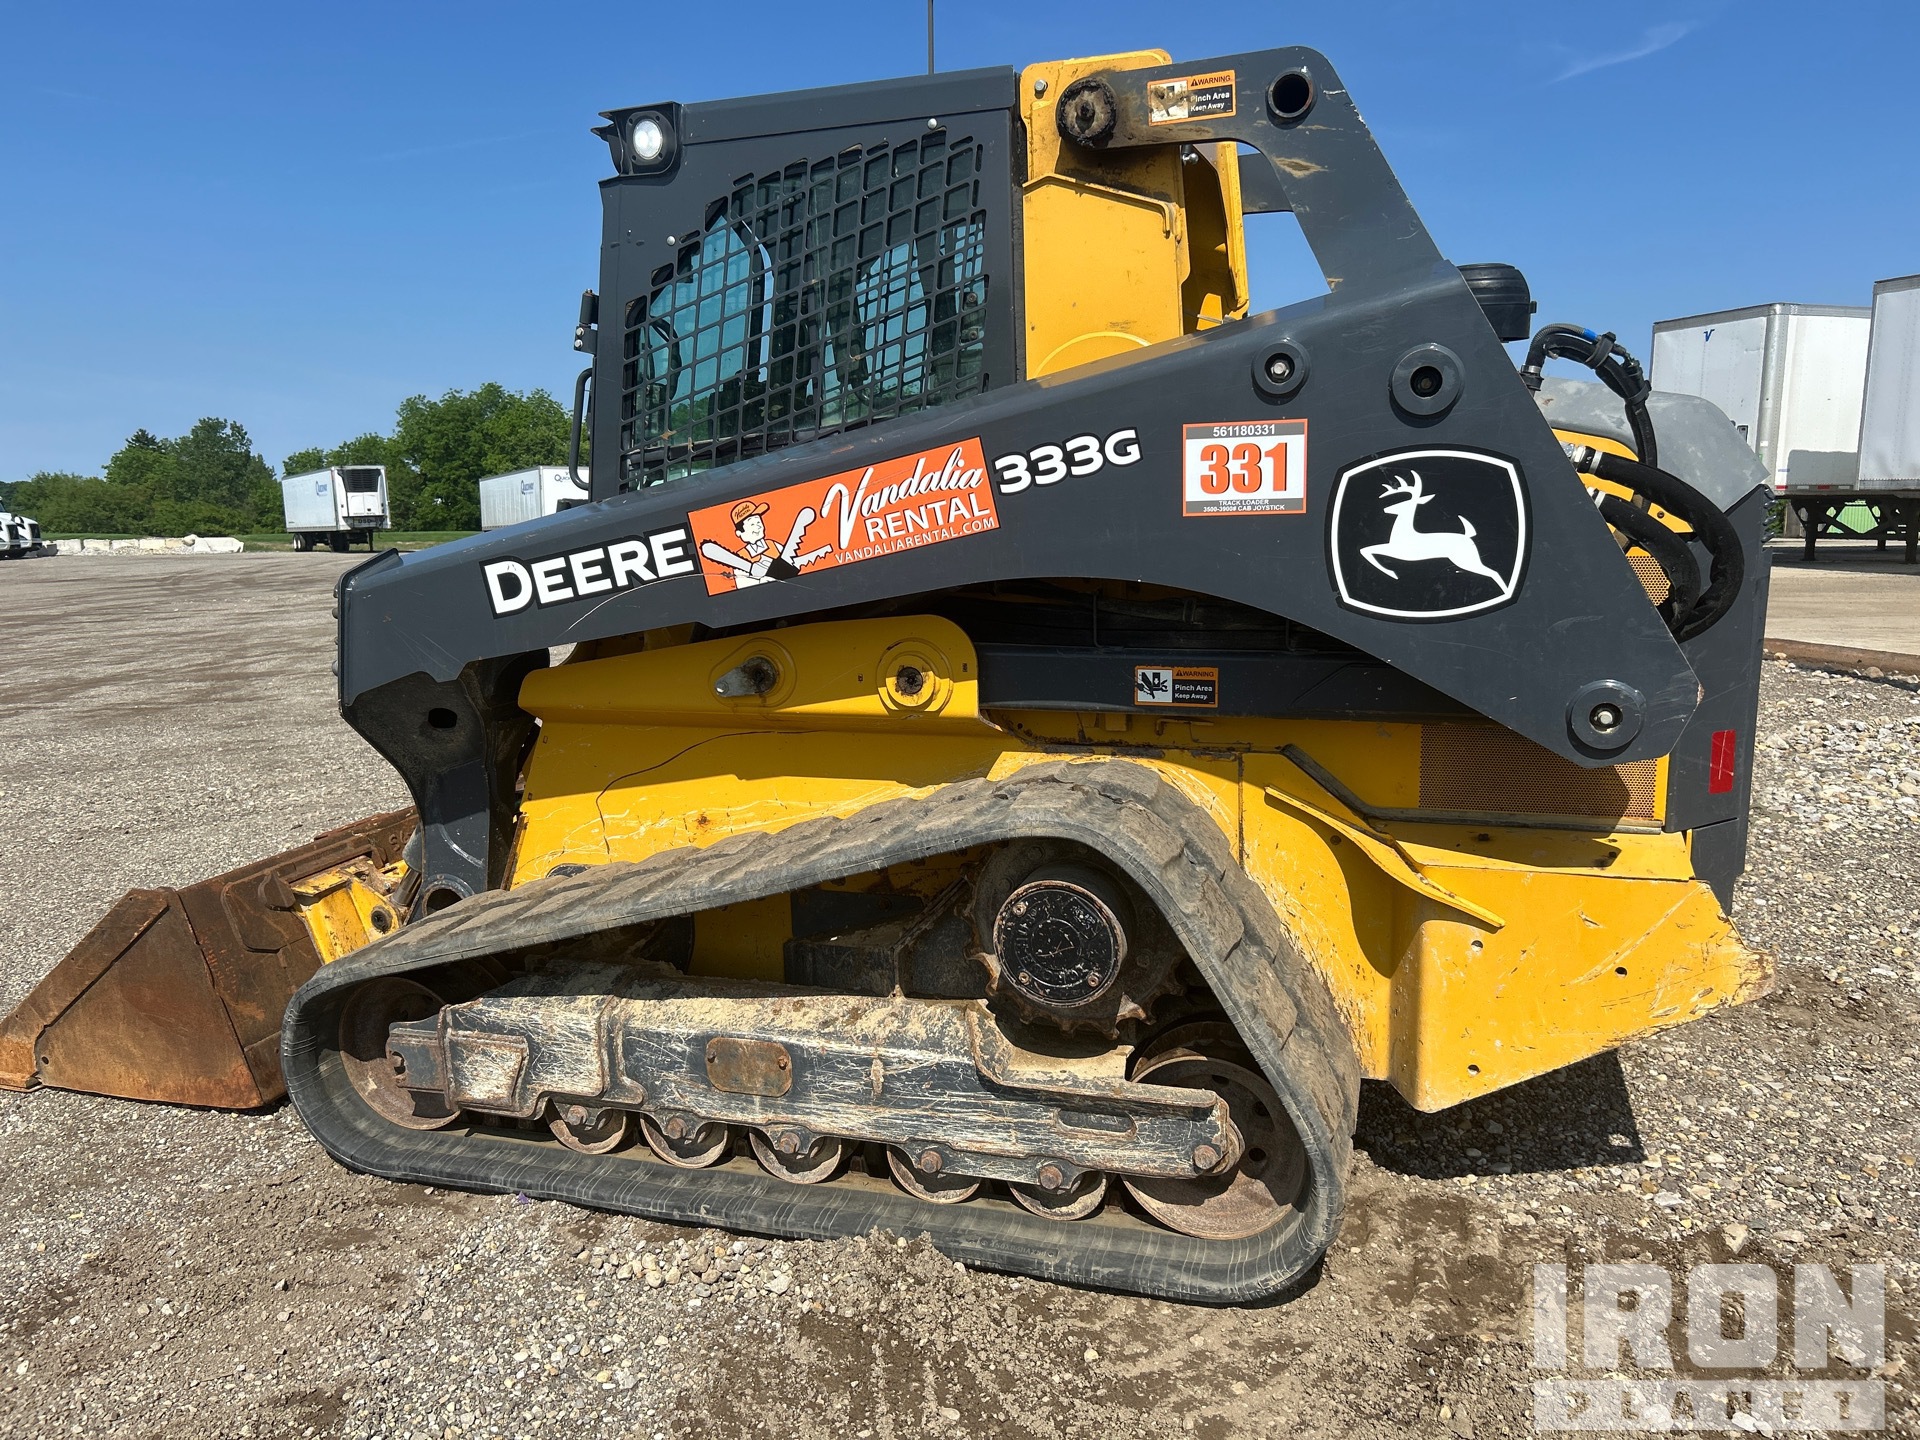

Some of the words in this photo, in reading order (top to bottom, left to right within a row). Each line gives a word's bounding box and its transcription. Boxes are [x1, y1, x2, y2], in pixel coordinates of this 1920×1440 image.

[1190, 94, 1211, 103] Pinch
[1212, 91, 1230, 101] Area
[1197, 75, 1231, 86] WARNING
[1190, 103, 1206, 112] Keep
[1207, 101, 1225, 110] Away
[1212, 424, 1275, 437] 561180331
[994, 429, 1141, 493] 333G
[1200, 442, 1287, 494] 331
[820, 447, 983, 550] Vandalia
[864, 493, 990, 543] RENTAL
[835, 517, 995, 564] VANDALIARENTAL.COM
[484, 529, 694, 614] DEERE
